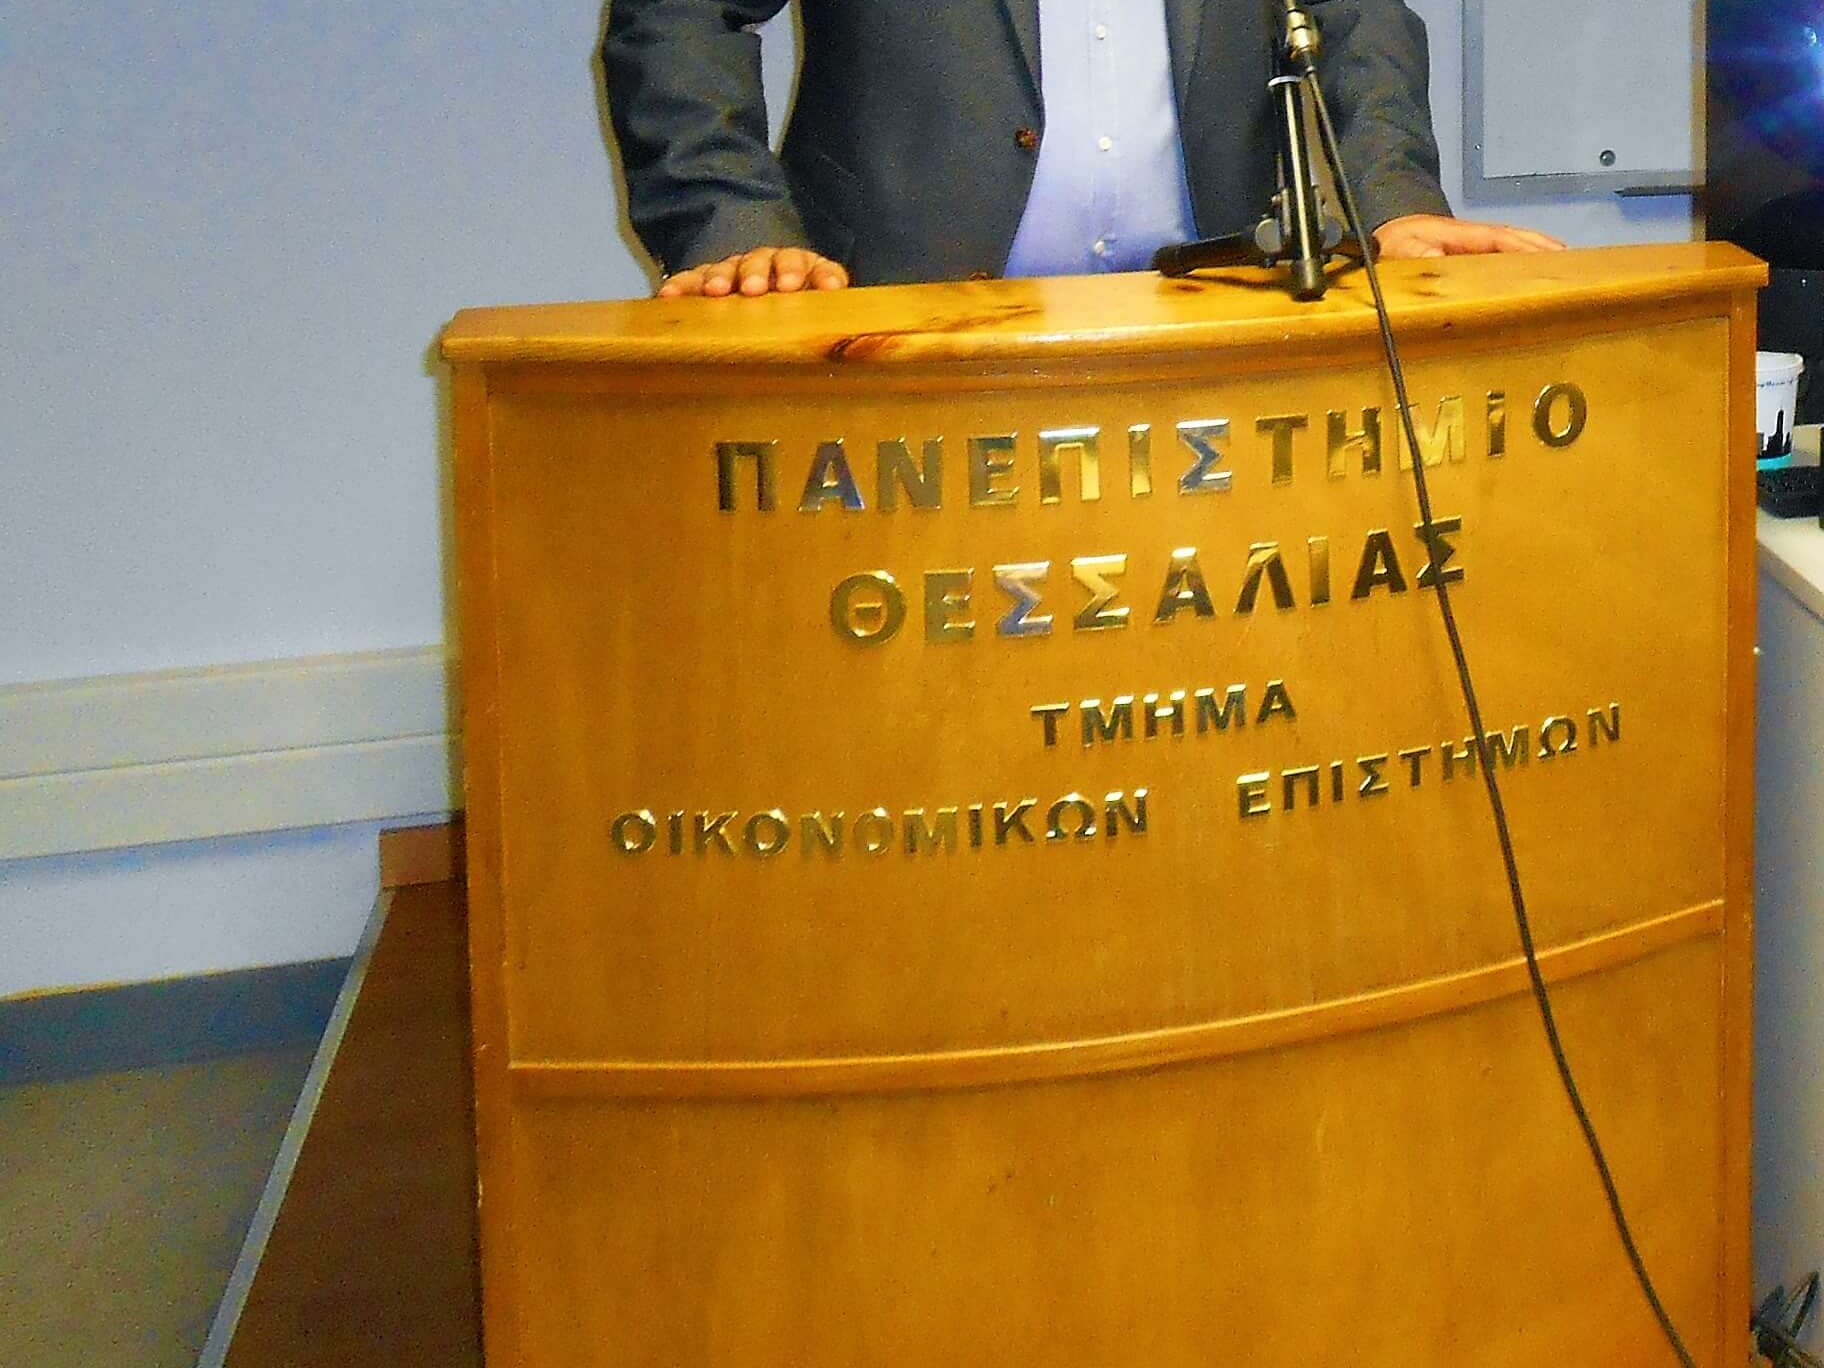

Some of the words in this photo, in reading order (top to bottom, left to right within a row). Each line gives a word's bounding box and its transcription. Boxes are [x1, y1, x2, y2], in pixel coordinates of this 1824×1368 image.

[714, 381, 1588, 512] ΠΑΝΕΠΙΣΤΗΜΙΟ
[829, 515, 1465, 647] ΘΕΣΣΑΛΙΑΣ
[610, 787, 1150, 857] ΟΙΚΟΝΟΜΙΚΩΝ
[1236, 701, 1621, 819] ΕΠΙΣΤΗΜΩΝ
[1030, 679, 1297, 748] ΤΜΗΜΑ
